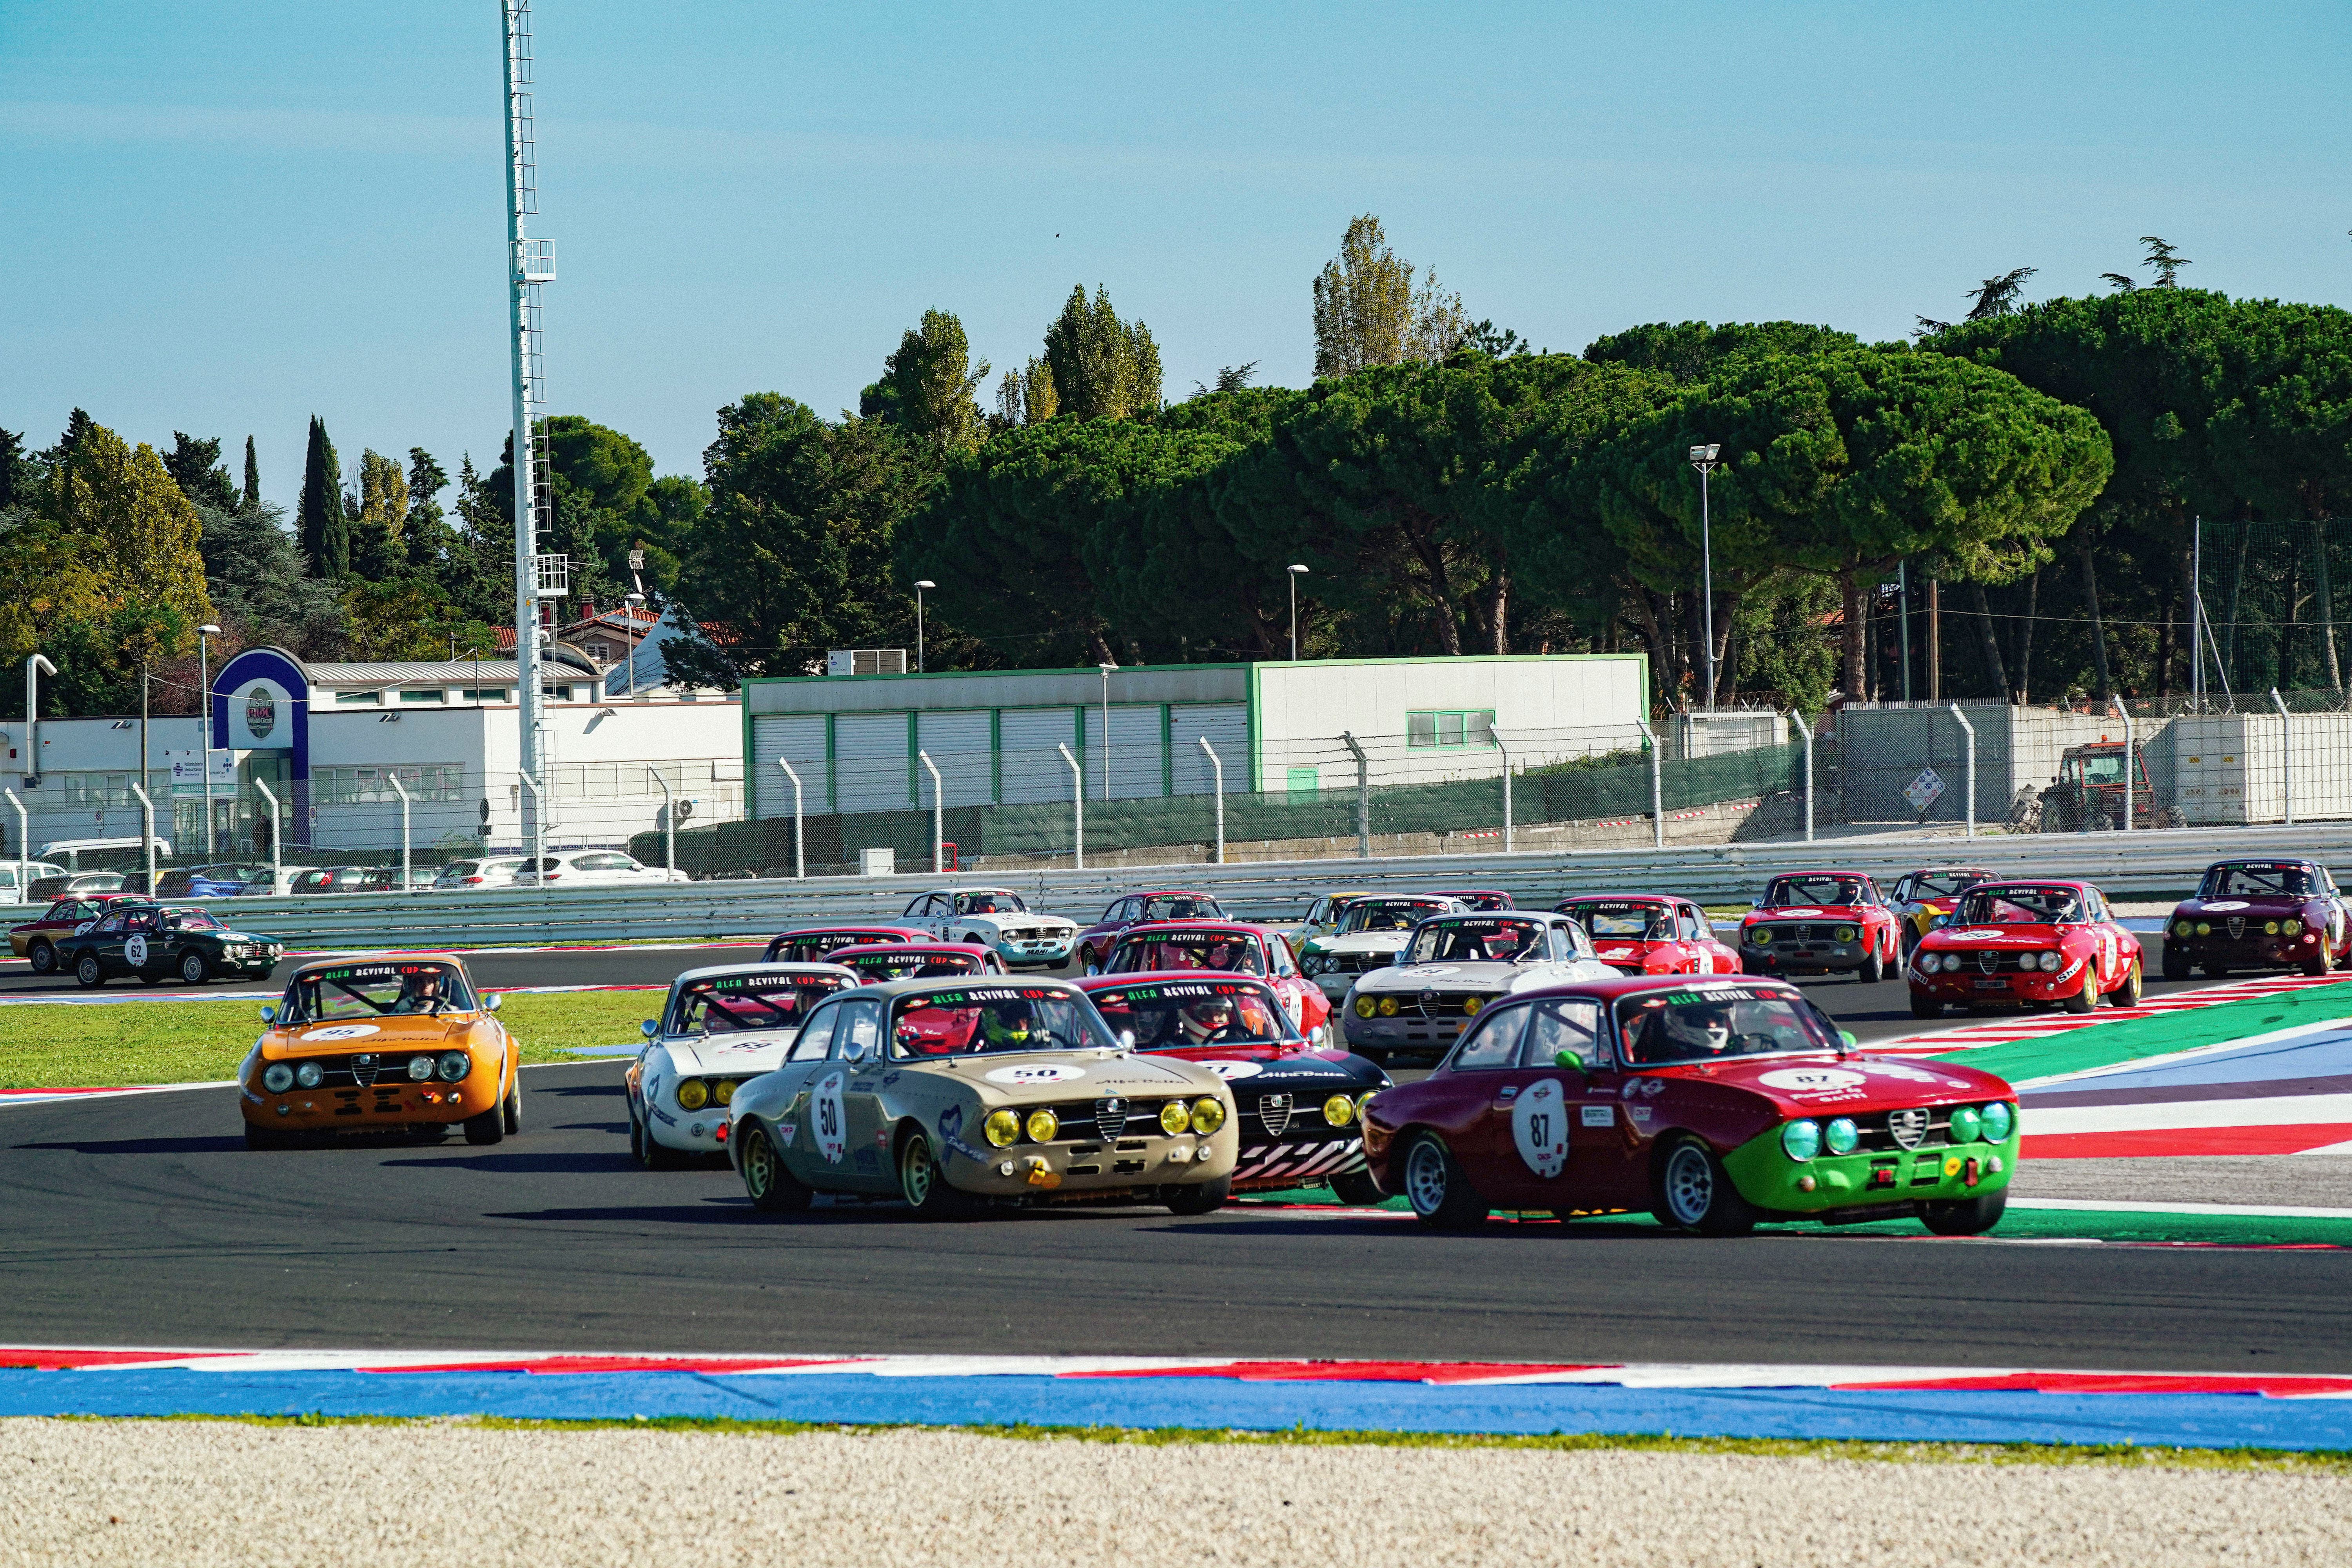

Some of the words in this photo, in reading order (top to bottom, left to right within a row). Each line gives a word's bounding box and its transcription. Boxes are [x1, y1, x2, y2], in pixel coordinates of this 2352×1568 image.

[131, 945, 141, 957] 62
[325, 970, 350, 980] ALFA
[356, 967, 396, 976] REVIVAL
[1909, 967, 1928, 984] hell
[716, 979, 742, 989] ALFA
[748, 976, 792, 986] REVIVAL
[933, 993, 964, 1004] ALFA
[968, 989, 1020, 1000] REVIVAL
[1023, 990, 1044, 998] CUP
[1128, 989, 1158, 1000] ALFA
[1163, 985, 1212, 997] REVIVAL
[1216, 985, 1236, 995] CUP
[820, 1098, 837, 1136] 50
[1530, 1114, 1549, 1147] 87
